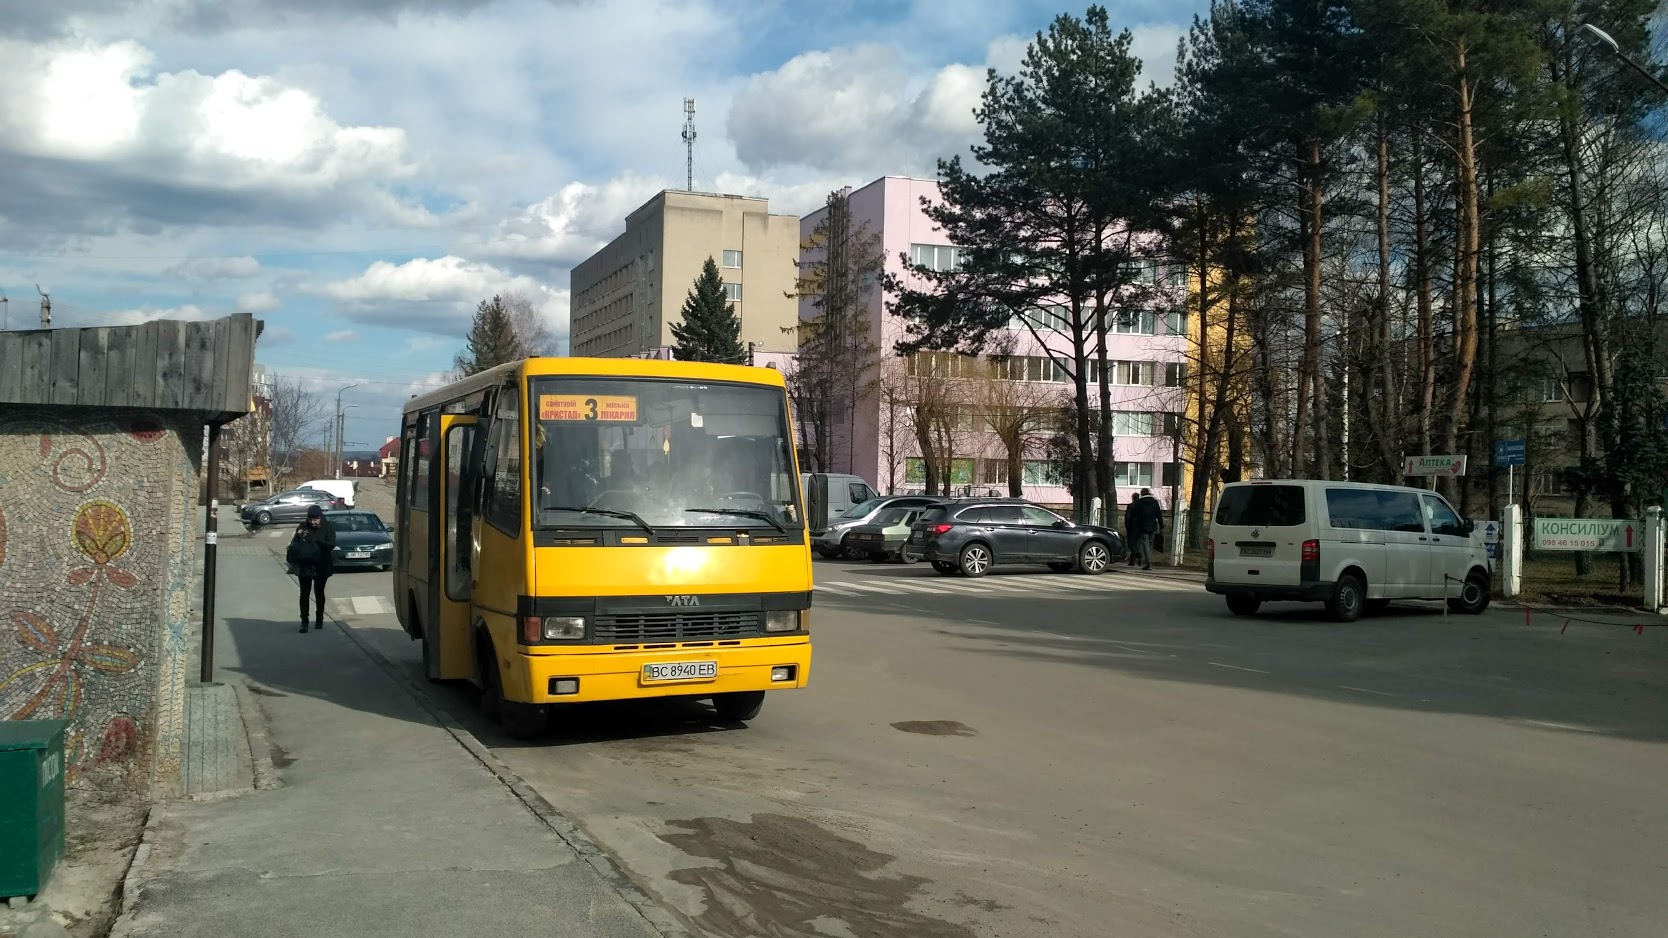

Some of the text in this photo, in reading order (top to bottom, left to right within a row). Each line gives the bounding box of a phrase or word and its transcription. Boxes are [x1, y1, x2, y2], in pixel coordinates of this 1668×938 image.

[584, 398, 598, 421] 3
[600, 411, 635, 419] ЛІКАРНЯ
[1542, 523, 1619, 536] КОНСИЛІУМ
[665, 596, 699, 606] TATA
[652, 664, 715, 677] BC 8940 EB
